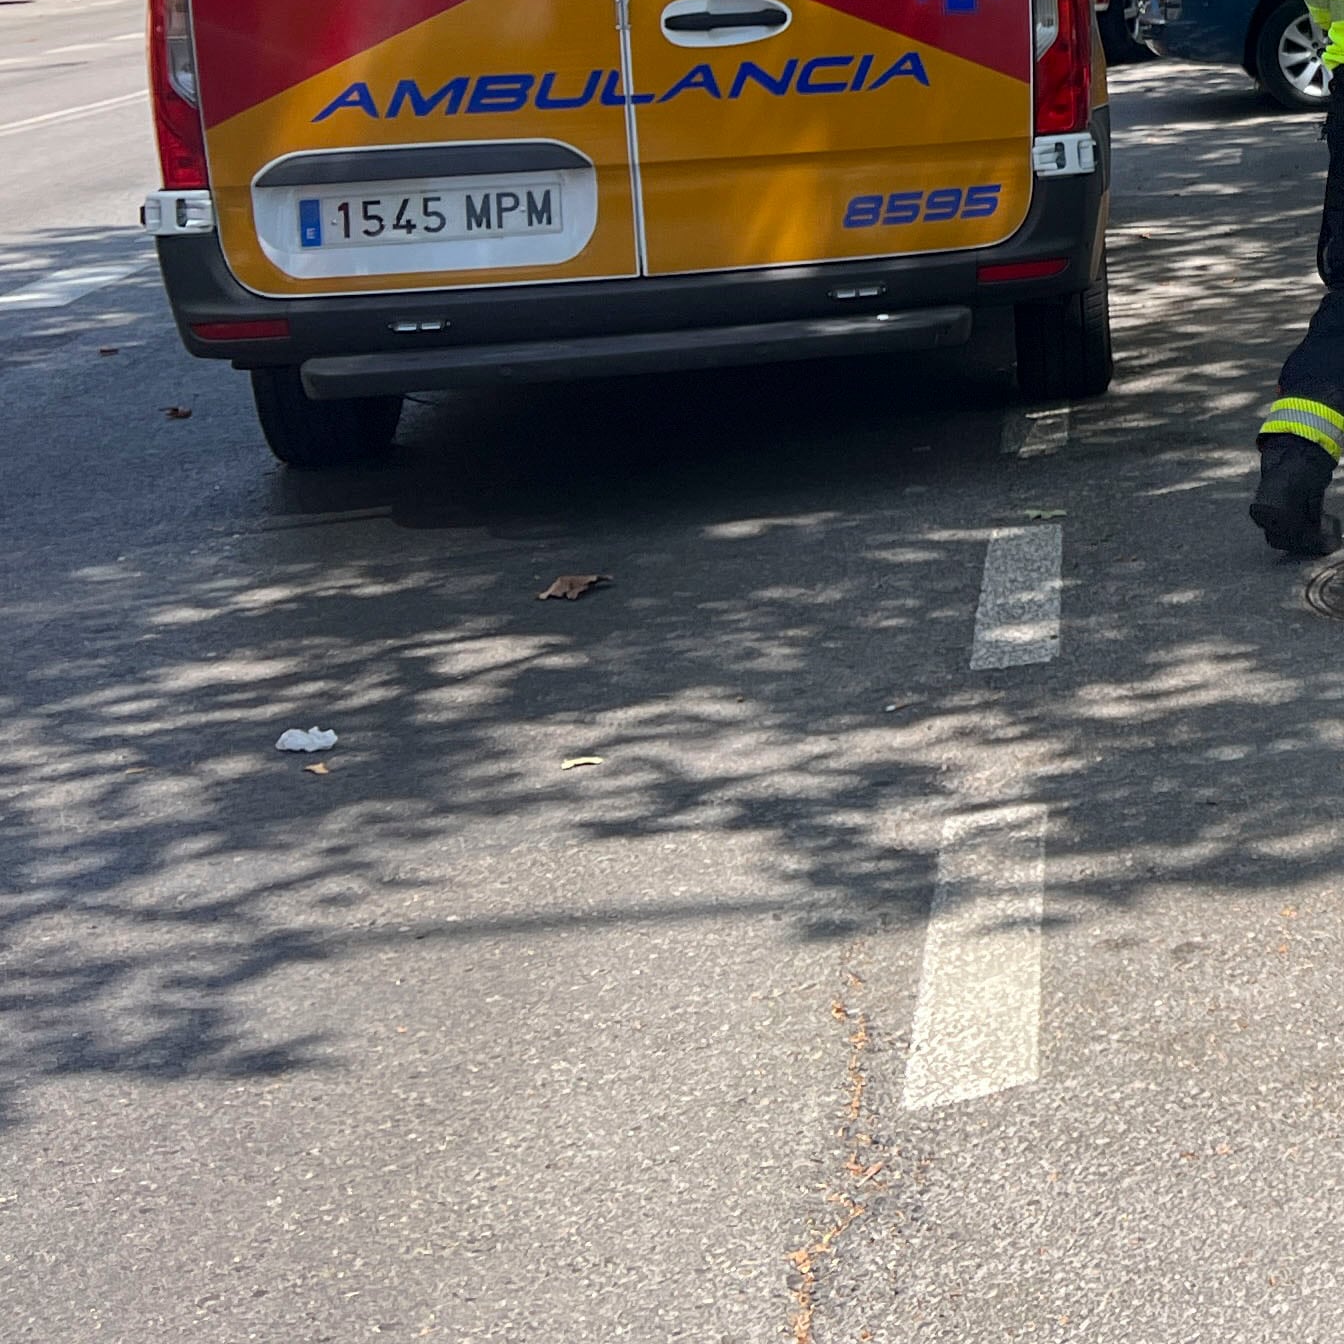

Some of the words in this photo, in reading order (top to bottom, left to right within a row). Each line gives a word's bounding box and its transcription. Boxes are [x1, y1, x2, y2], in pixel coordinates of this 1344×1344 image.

[310, 51, 931, 123] AMBULANCIA
[306, 226, 316, 240] E
[337, 196, 447, 239] 1545
[465, 188, 553, 231] MPM
[841, 183, 1002, 229] 8595
